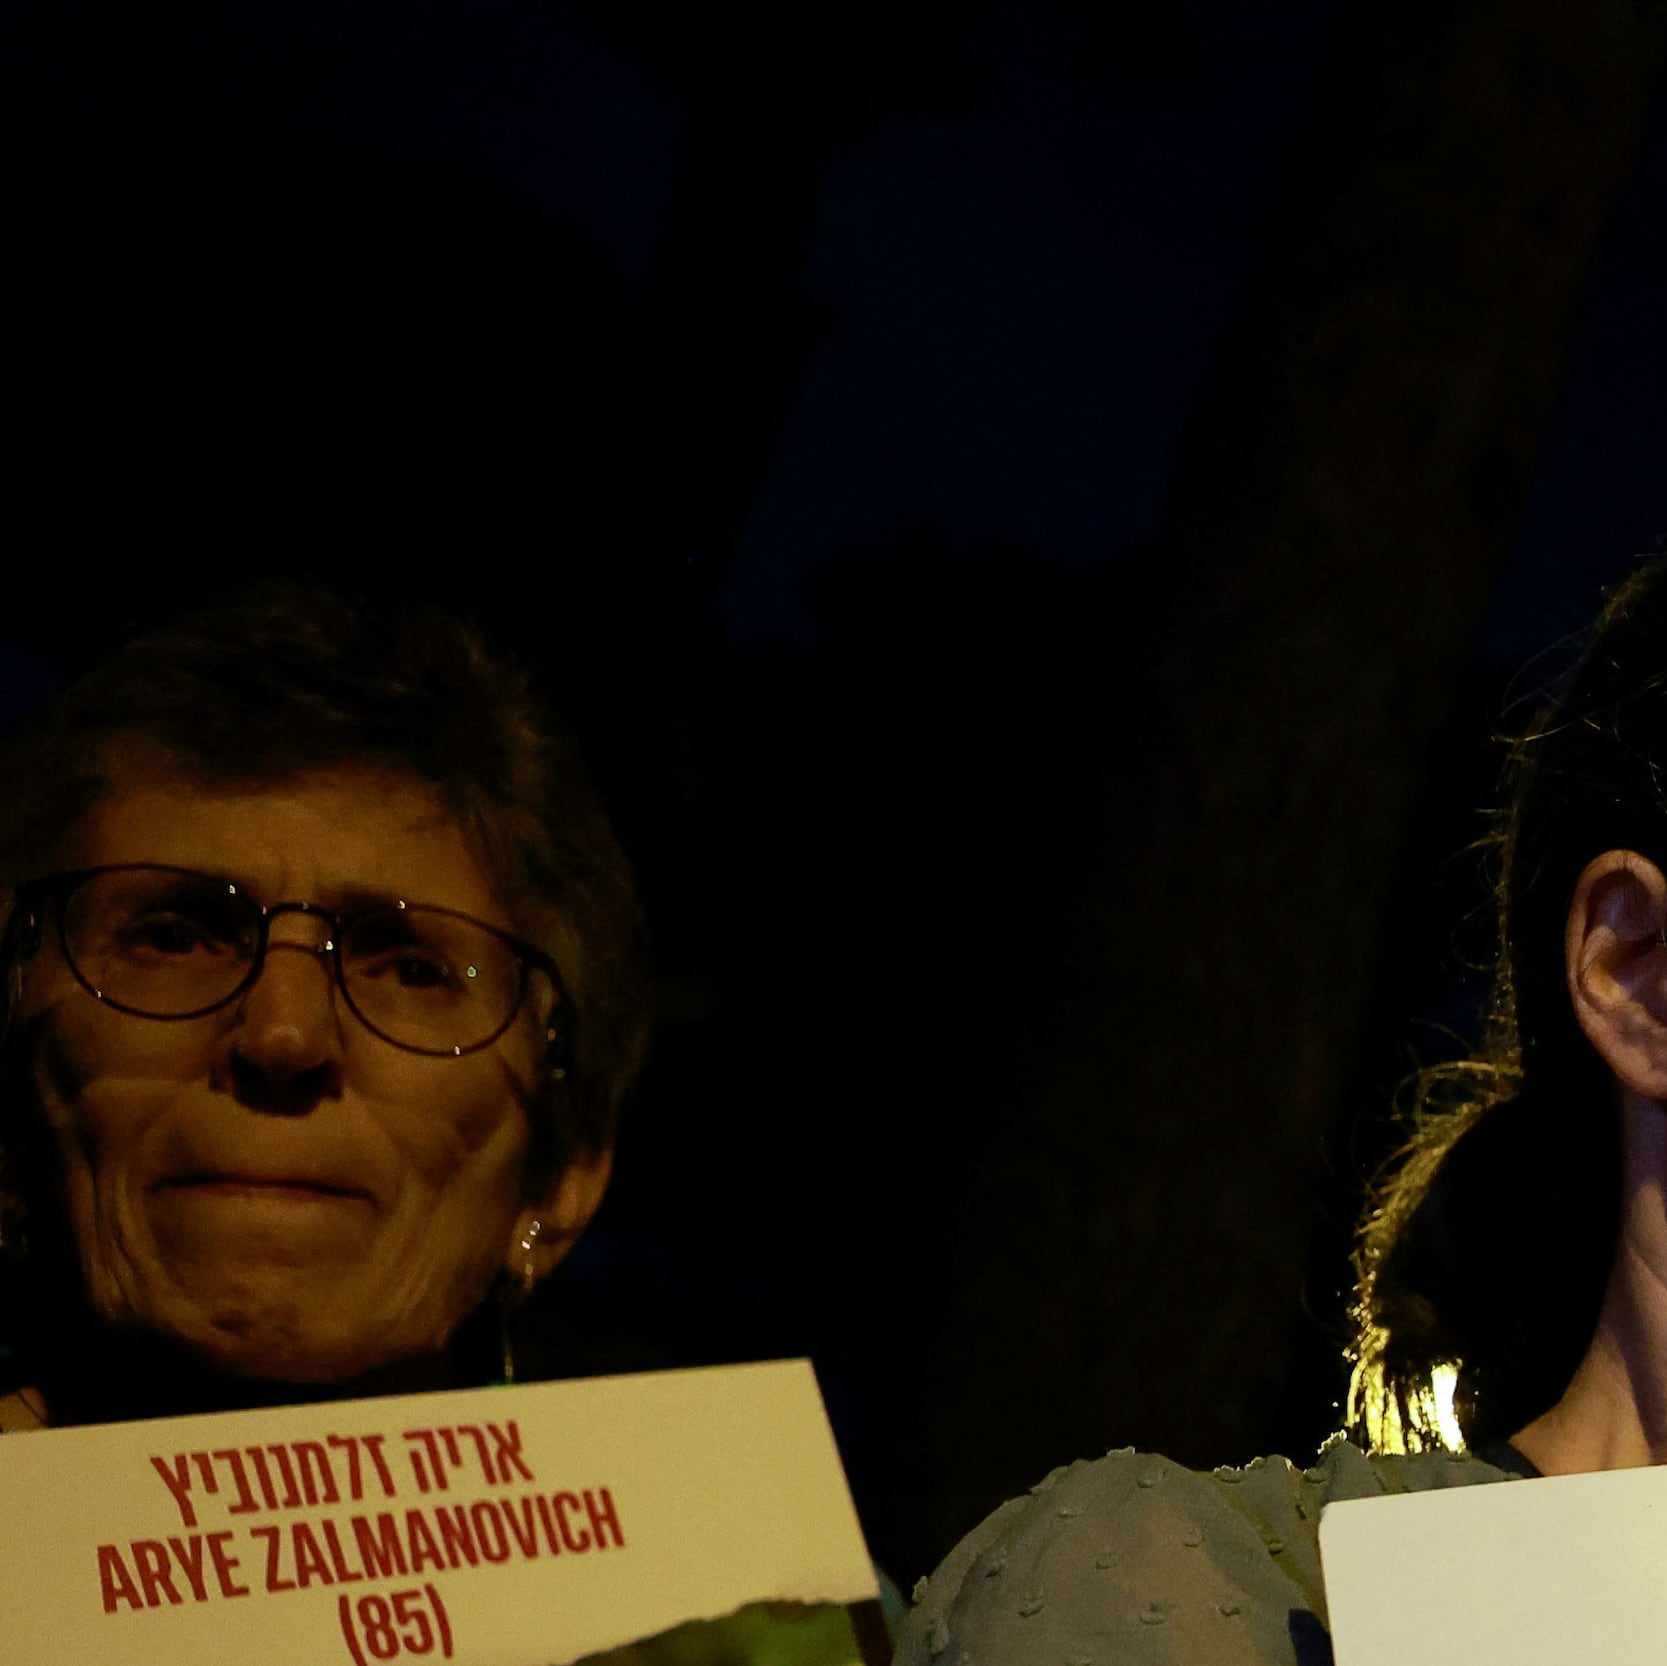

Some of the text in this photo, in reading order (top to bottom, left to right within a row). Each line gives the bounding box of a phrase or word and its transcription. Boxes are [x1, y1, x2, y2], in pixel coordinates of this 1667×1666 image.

[151, 1420, 535, 1526] אריה זלמנוביץ
[96, 1487, 626, 1614] ARYE ZALMANOVICH
